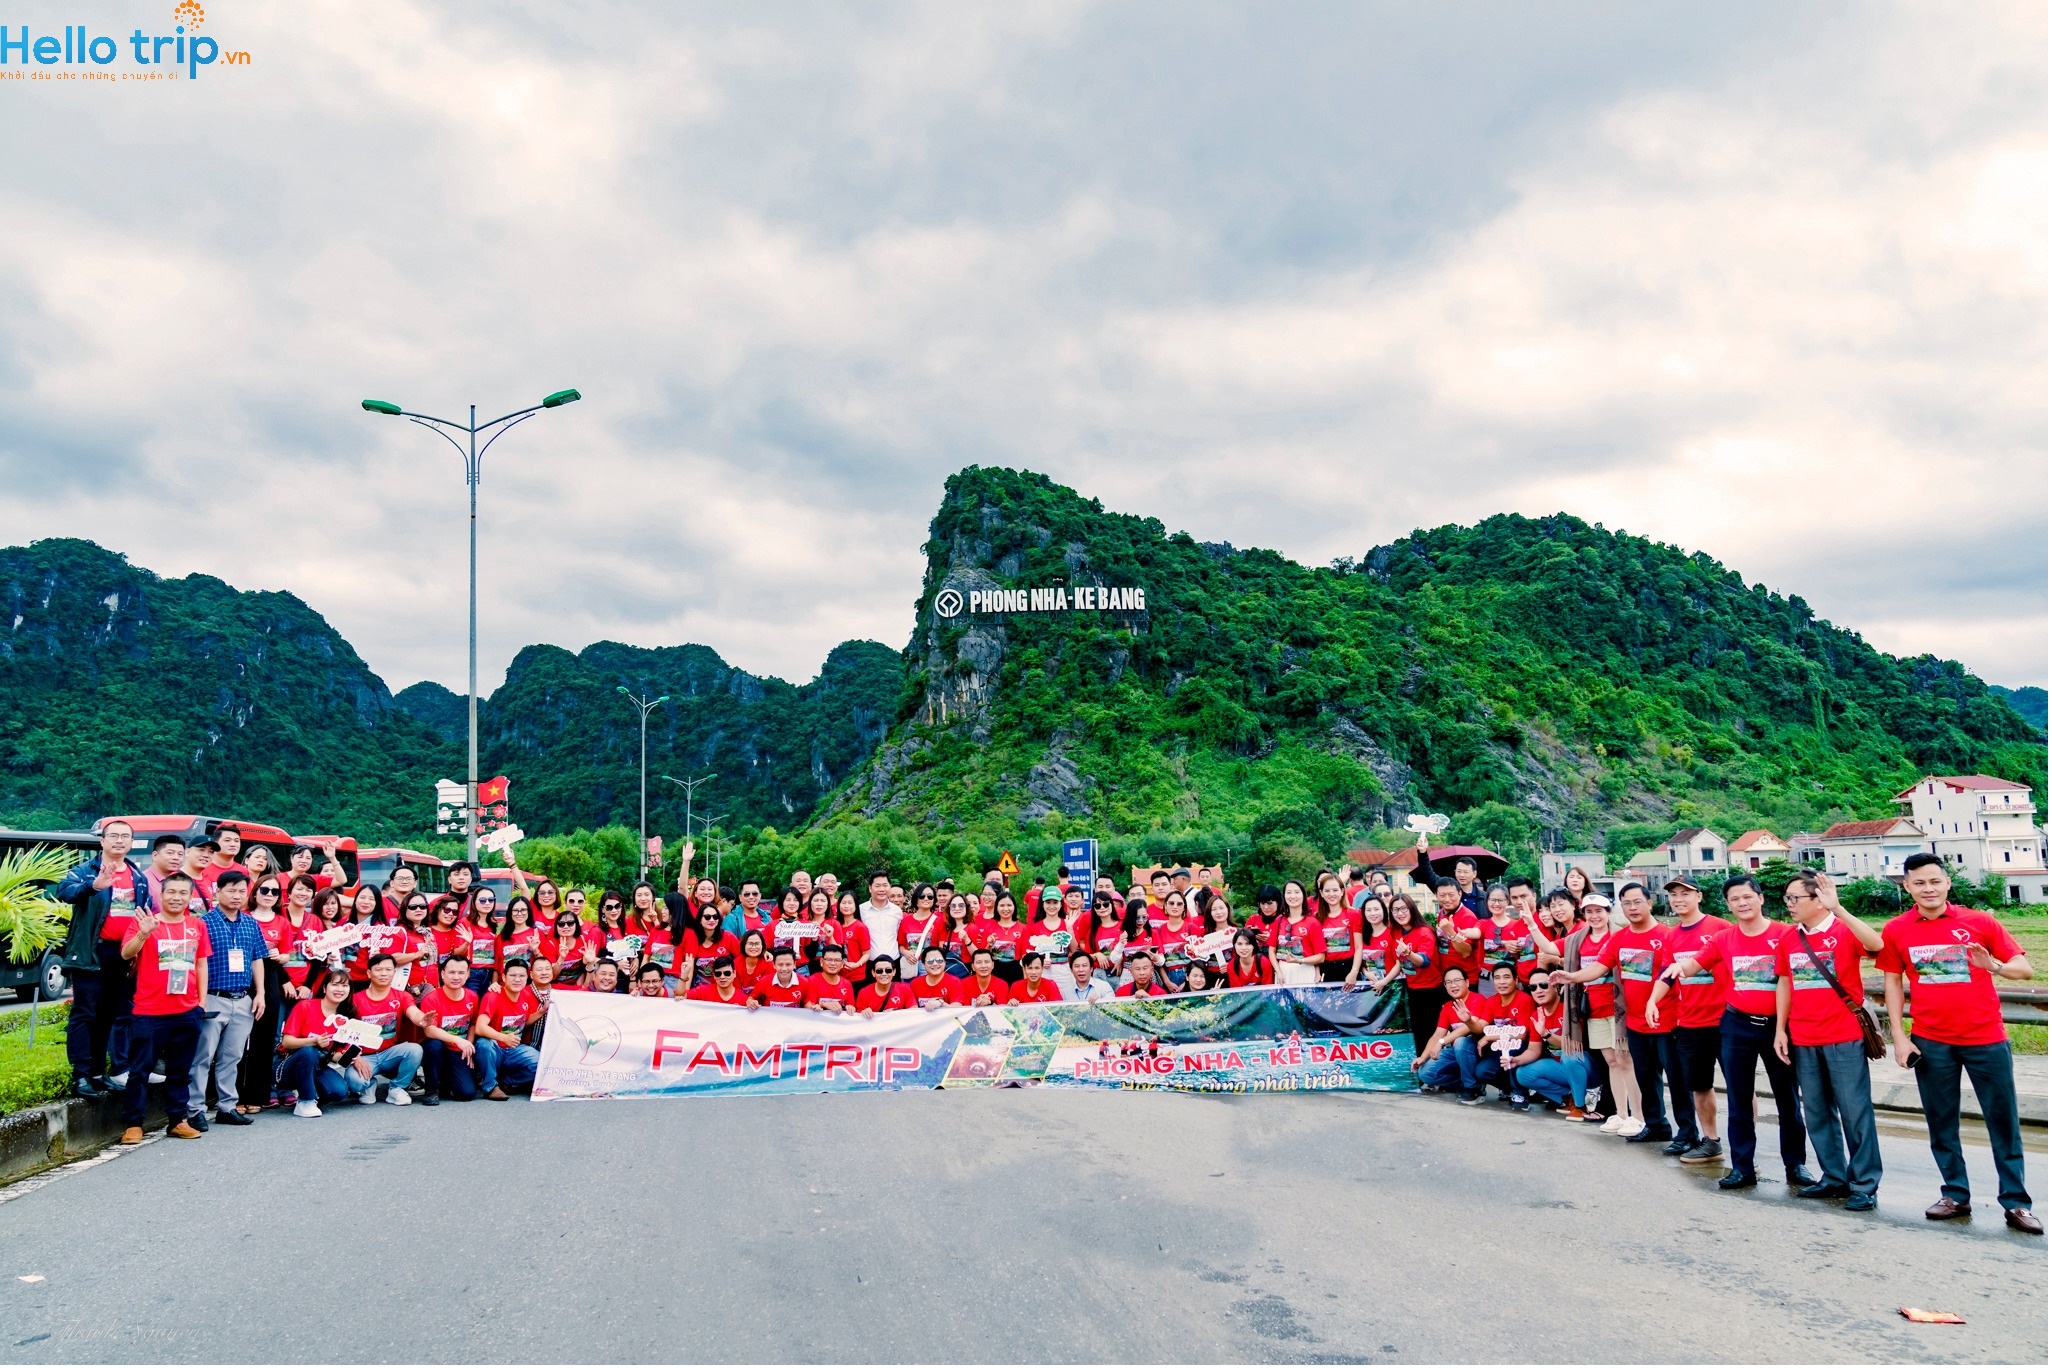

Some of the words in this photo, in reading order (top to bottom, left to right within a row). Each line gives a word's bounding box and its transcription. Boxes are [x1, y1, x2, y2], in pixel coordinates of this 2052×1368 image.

[970, 590, 1028, 613] PHONG
[1098, 587, 1145, 610] BANG
[650, 1029, 922, 1083] FAMTRIP
[1075, 1056, 1175, 1077] PHONG
[1184, 1052, 1244, 1072] NHA
[1310, 1040, 1392, 1063] BÀNG
[1254, 1071, 1299, 1093] phát
[1304, 1063, 1352, 1089] triển
